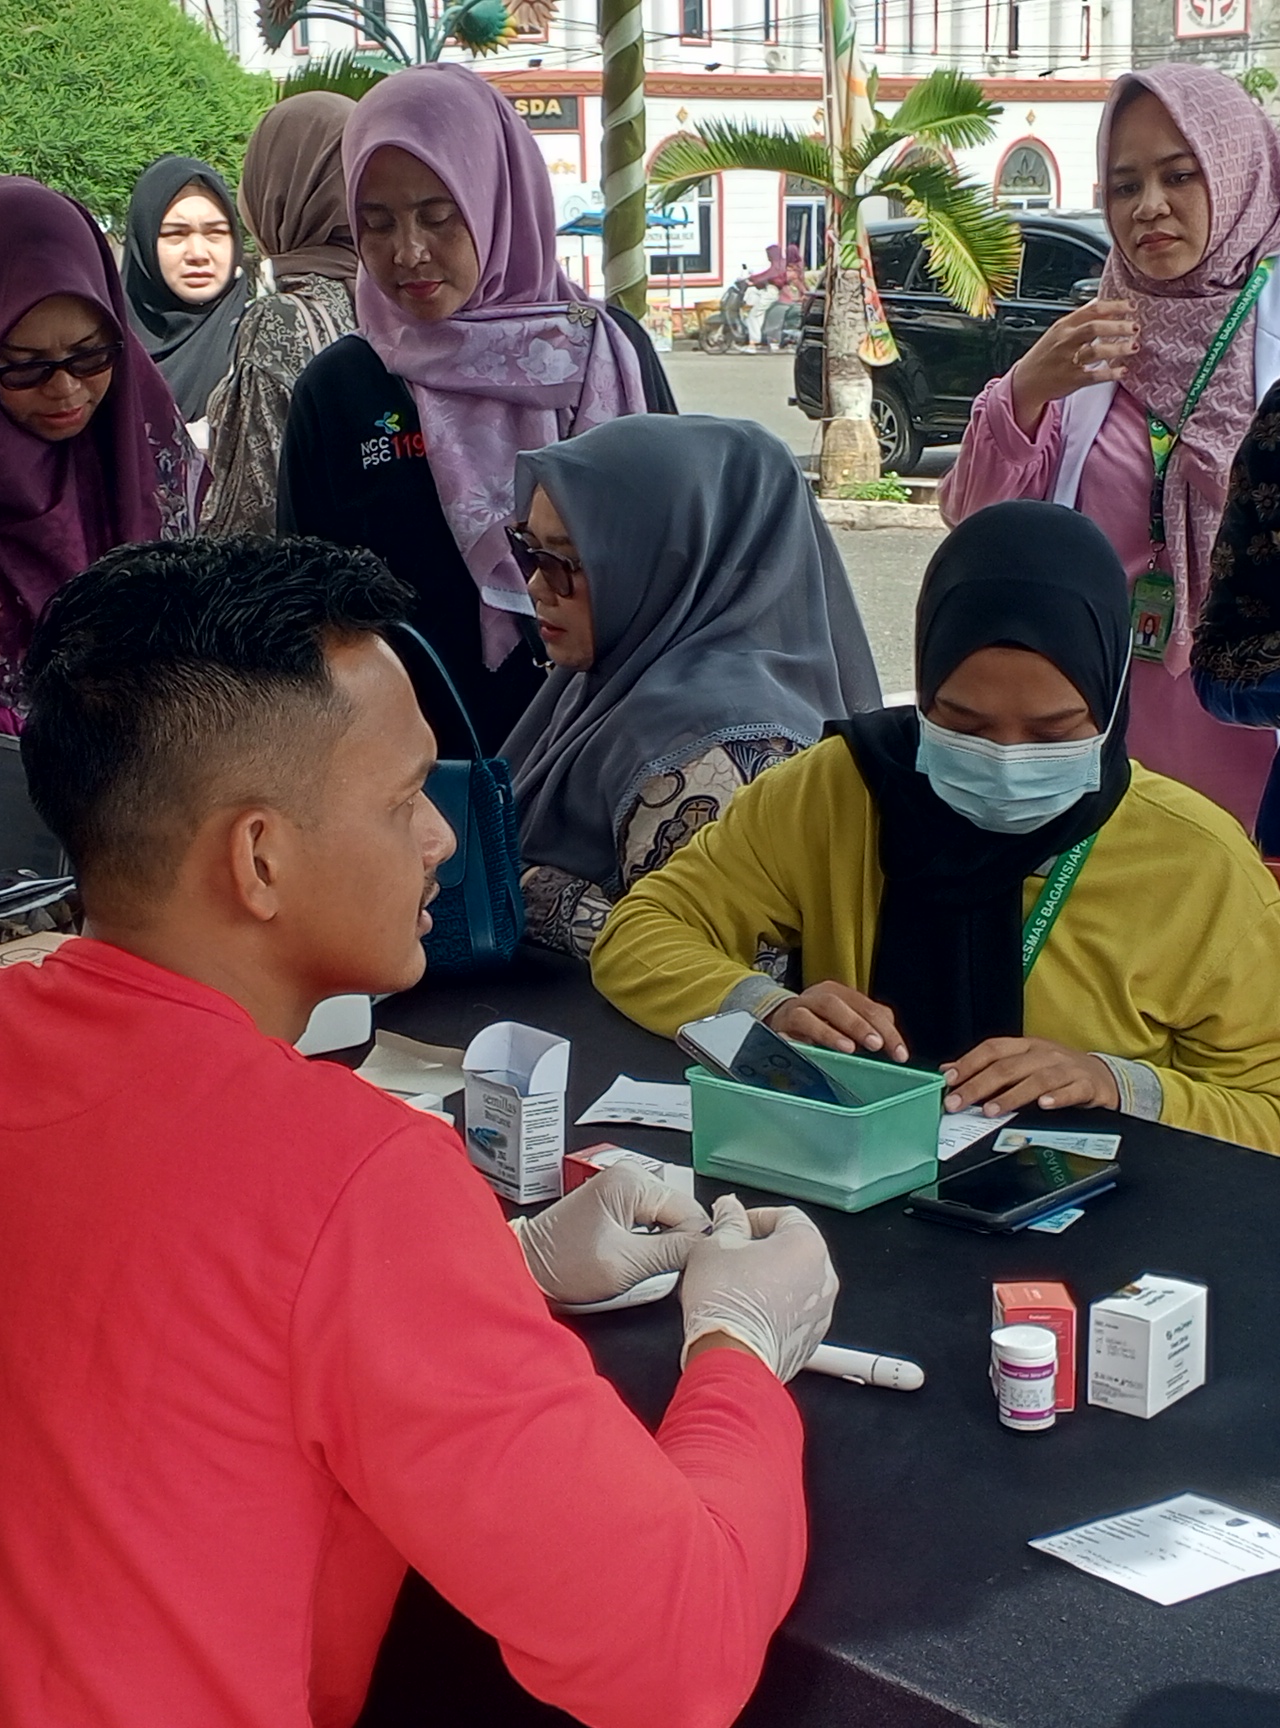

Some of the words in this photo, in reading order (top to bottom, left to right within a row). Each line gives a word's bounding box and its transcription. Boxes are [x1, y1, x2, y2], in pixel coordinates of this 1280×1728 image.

[514, 98, 562, 116] SDA
[1190, 341, 1224, 396] PUSKESMAS
[1218, 274, 1265, 341] BAGANSIAPIAPI
[360, 436, 389, 456] NCC
[390, 433, 424, 459] 119
[362, 449, 391, 470] PSC
[1022, 917, 1047, 966] ESMAS
